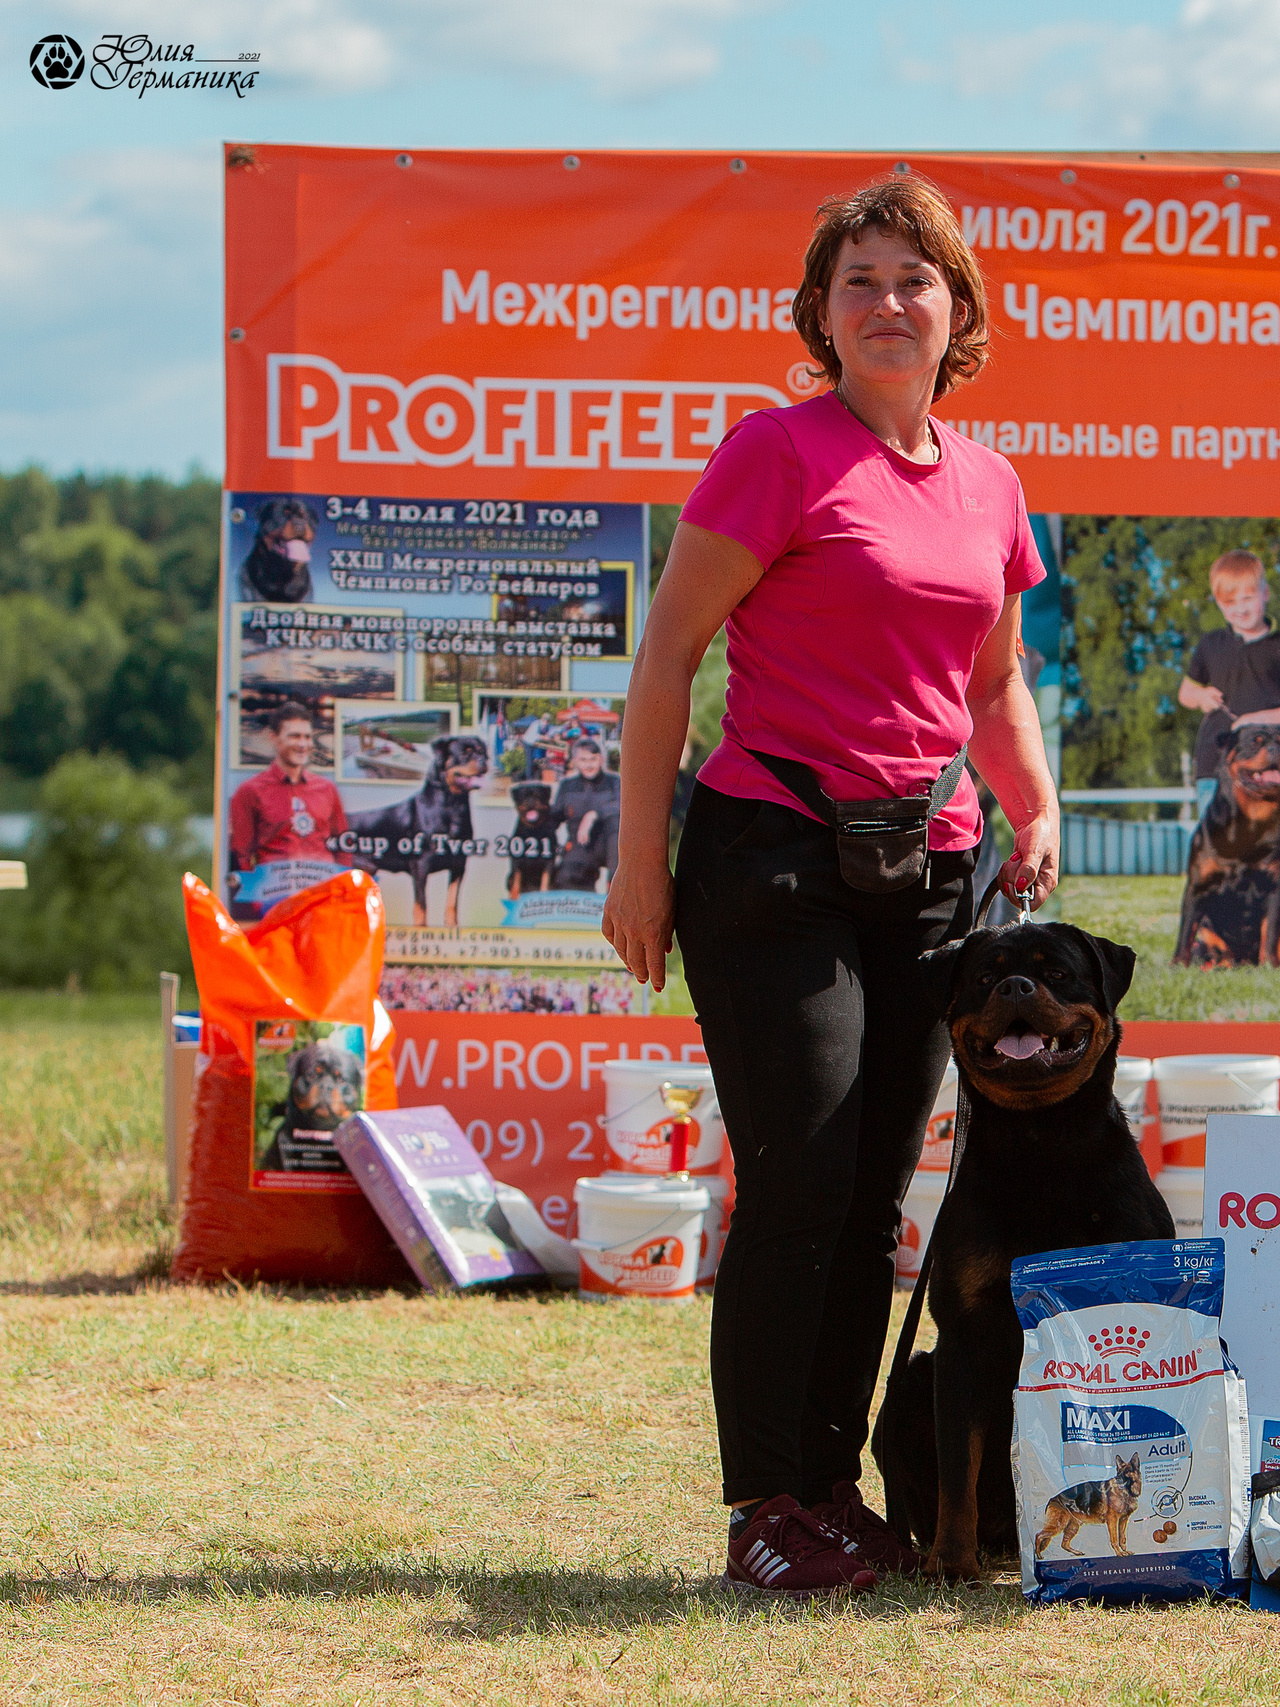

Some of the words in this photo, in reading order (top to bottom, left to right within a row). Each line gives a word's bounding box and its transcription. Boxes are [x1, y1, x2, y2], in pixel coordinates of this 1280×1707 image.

[1121, 199, 1278, 258] 2021г.
[326, 497, 370, 521] 3-4
[379, 503, 457, 523] июля
[463, 502, 526, 526] 2021
[536, 508, 600, 529] года
[391, 552, 600, 578] Межрегиональный
[331, 569, 452, 590] Чемпионат
[458, 575, 600, 600] Ротвейлеров
[250, 608, 343, 630] Двойная
[350, 615, 503, 638] монопородная
[509, 619, 617, 637] выставка
[266, 628, 313, 648] КЧК
[341, 631, 388, 651] КЧК
[414, 635, 496, 654] особым
[502, 638, 602, 660] статусом
[397, 832, 425, 856] of
[431, 834, 488, 857] Tver
[1173, 1256, 1181, 1267] 3
[1043, 1359, 1118, 1384] ROYAL
[1122, 1350, 1198, 1381] CANIN
[1066, 1407, 1130, 1431] MAXI
[1147, 1440, 1186, 1458] Adult
[1135, 1564, 1177, 1573] NUTRITION
